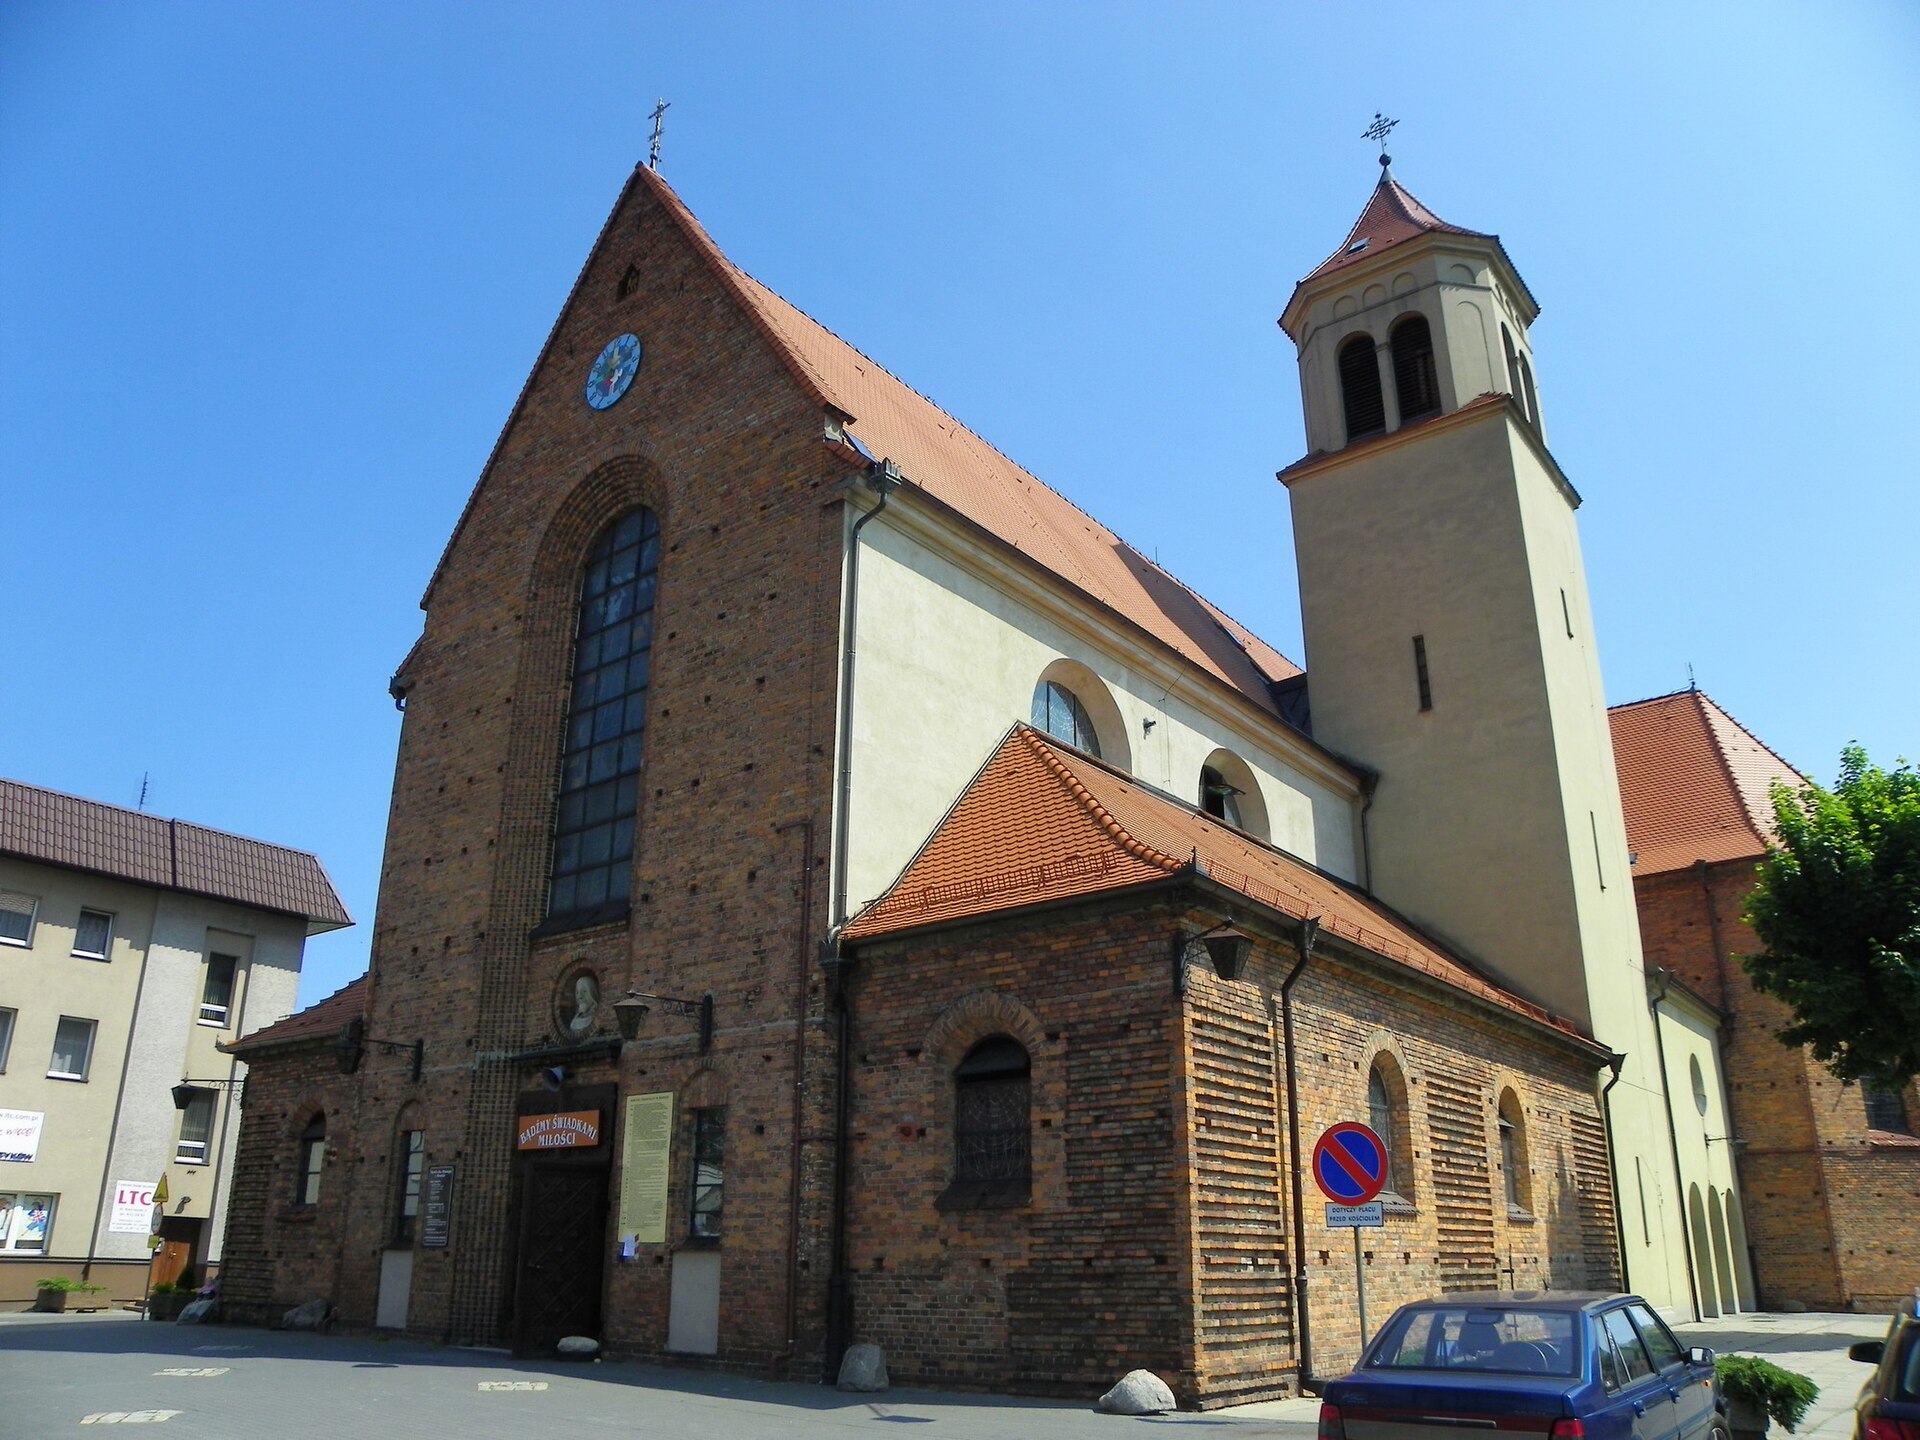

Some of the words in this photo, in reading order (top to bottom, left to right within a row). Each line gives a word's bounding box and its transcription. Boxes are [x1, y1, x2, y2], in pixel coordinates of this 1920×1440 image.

[520, 1119, 551, 1144] BĄDŹMY
[552, 1114, 597, 1140] ŚWIADKAMI
[538, 1130, 576, 1146] MIŁOŚCI
[118, 1190, 152, 1206] LTC
